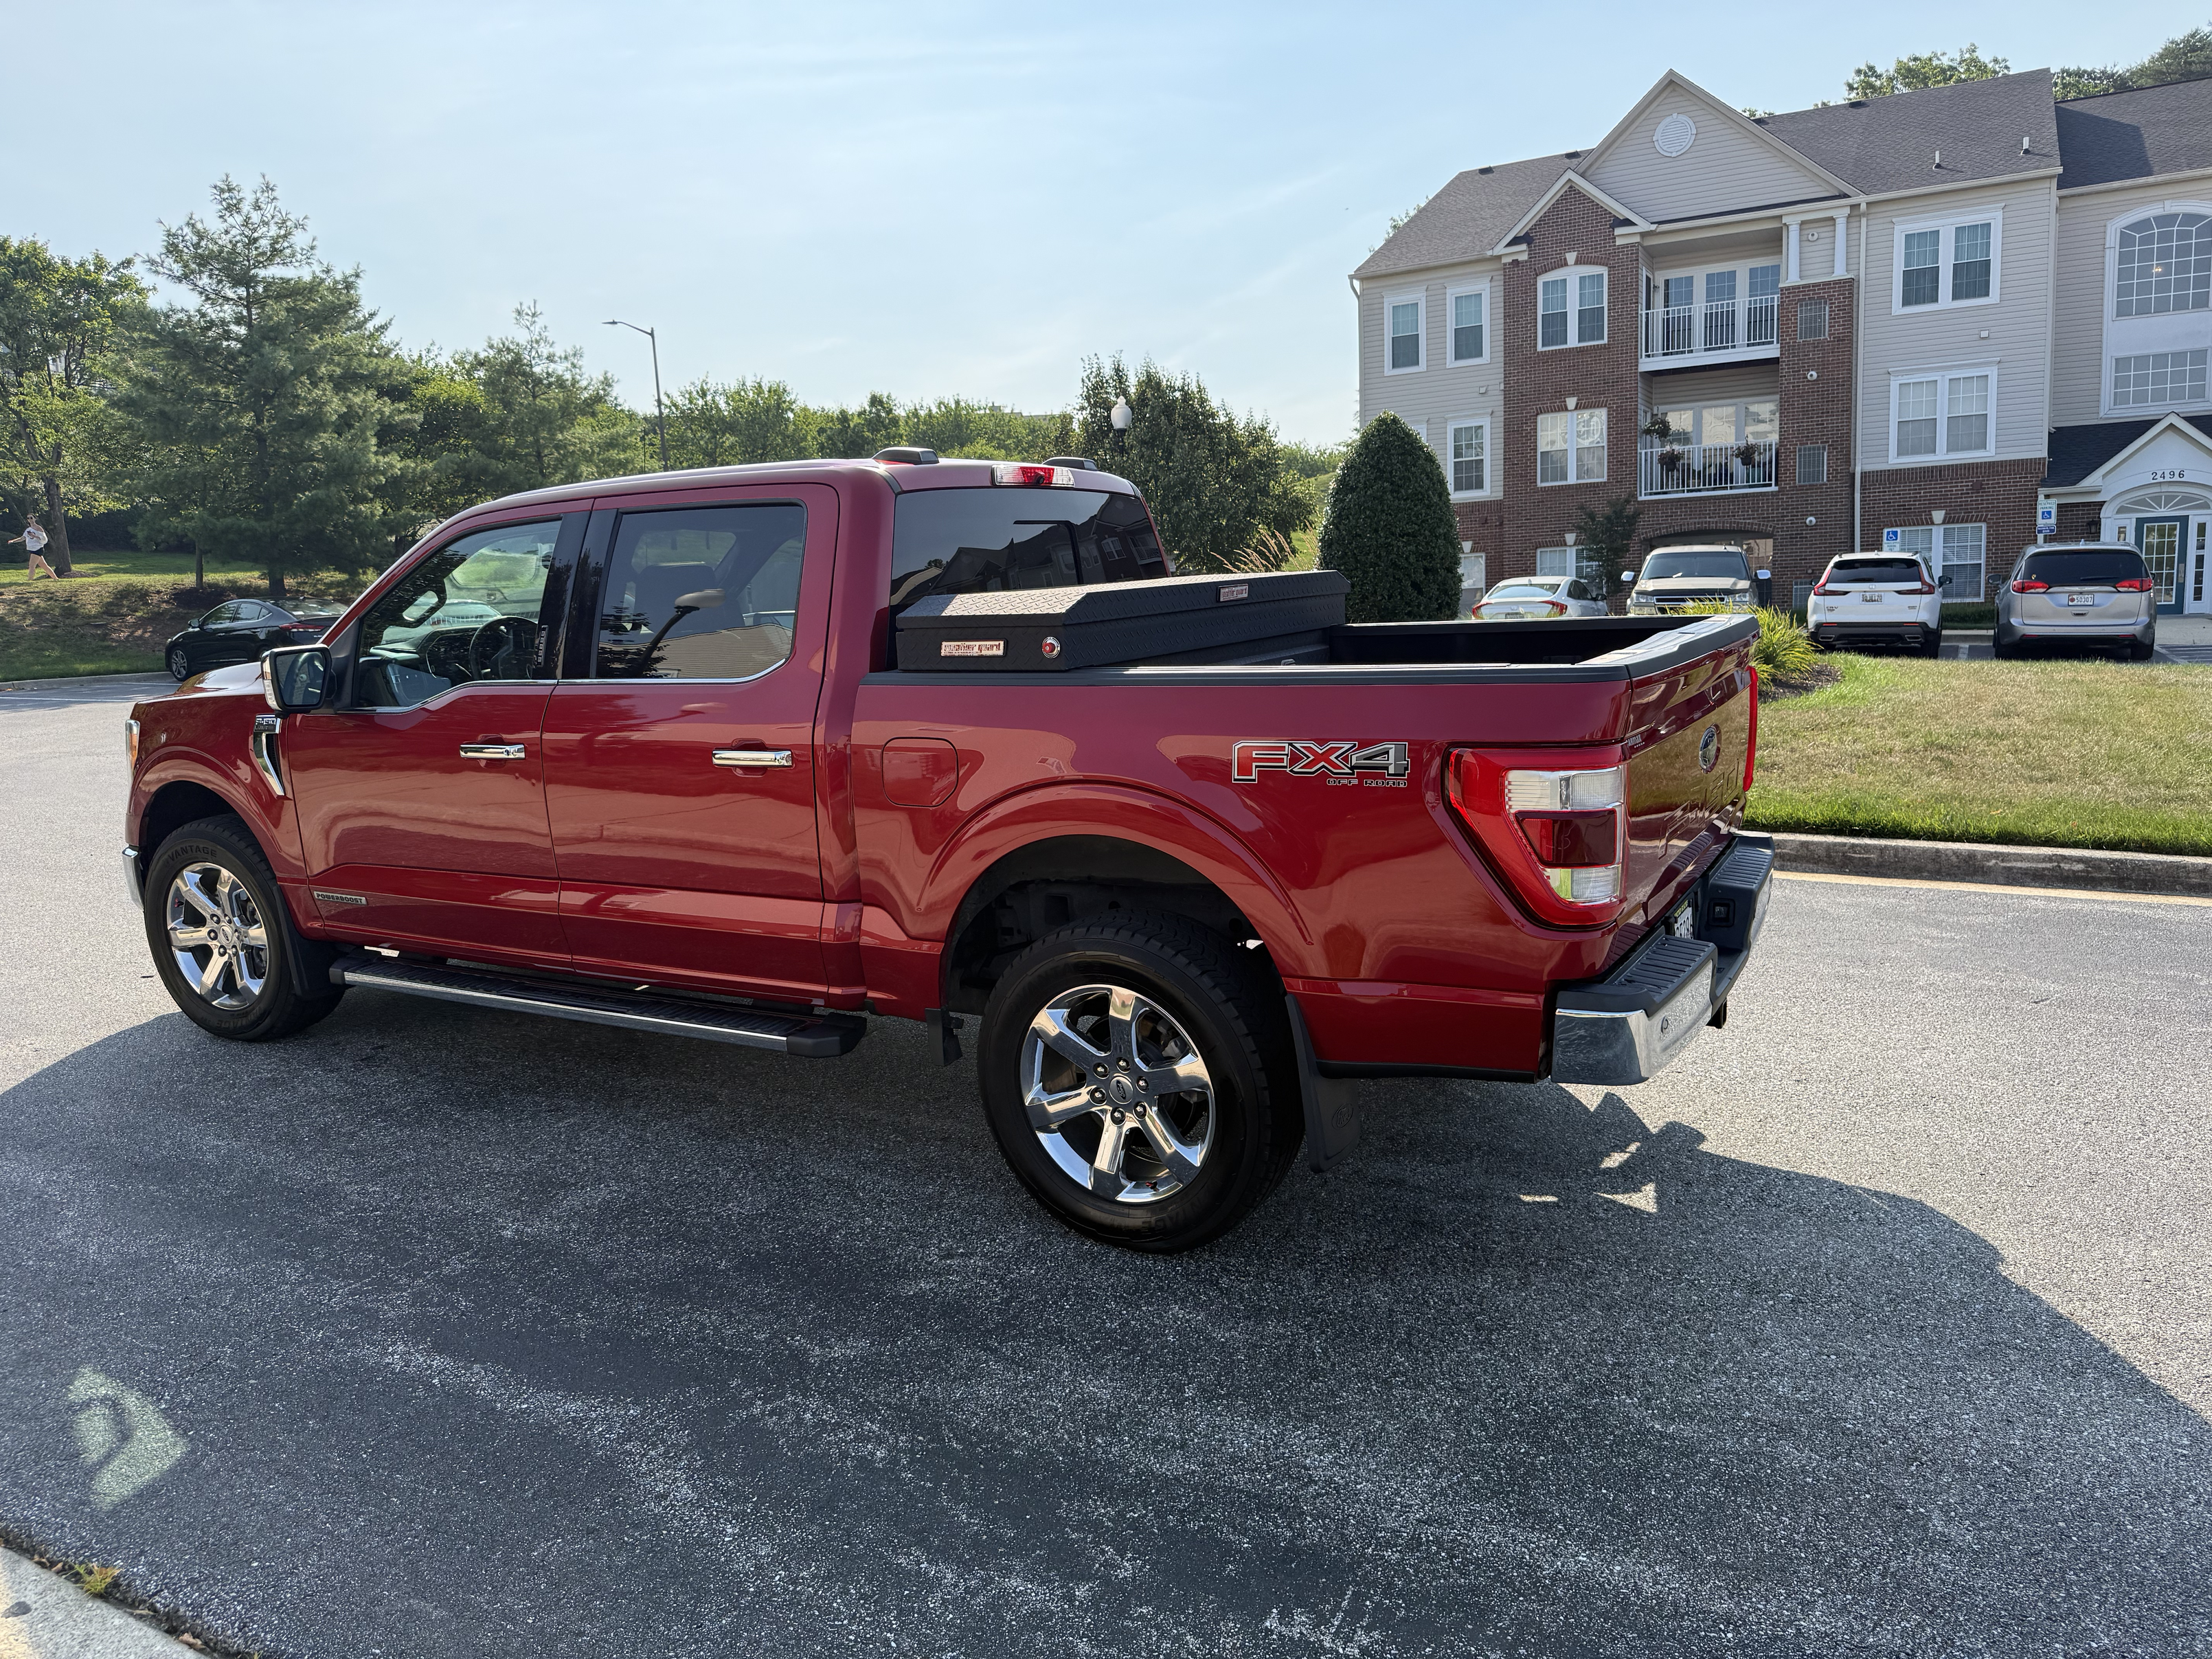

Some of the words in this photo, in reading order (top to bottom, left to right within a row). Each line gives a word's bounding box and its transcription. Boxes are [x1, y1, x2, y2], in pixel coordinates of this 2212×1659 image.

[2151, 470, 2185, 480] 2496
[1232, 740, 1410, 784] FX4
[1327, 778, 1359, 787] OFF
[1364, 779, 1408, 788] ROAD
[168, 845, 218, 861] VANTAGE
[316, 892, 363, 904] POWERBOOST
